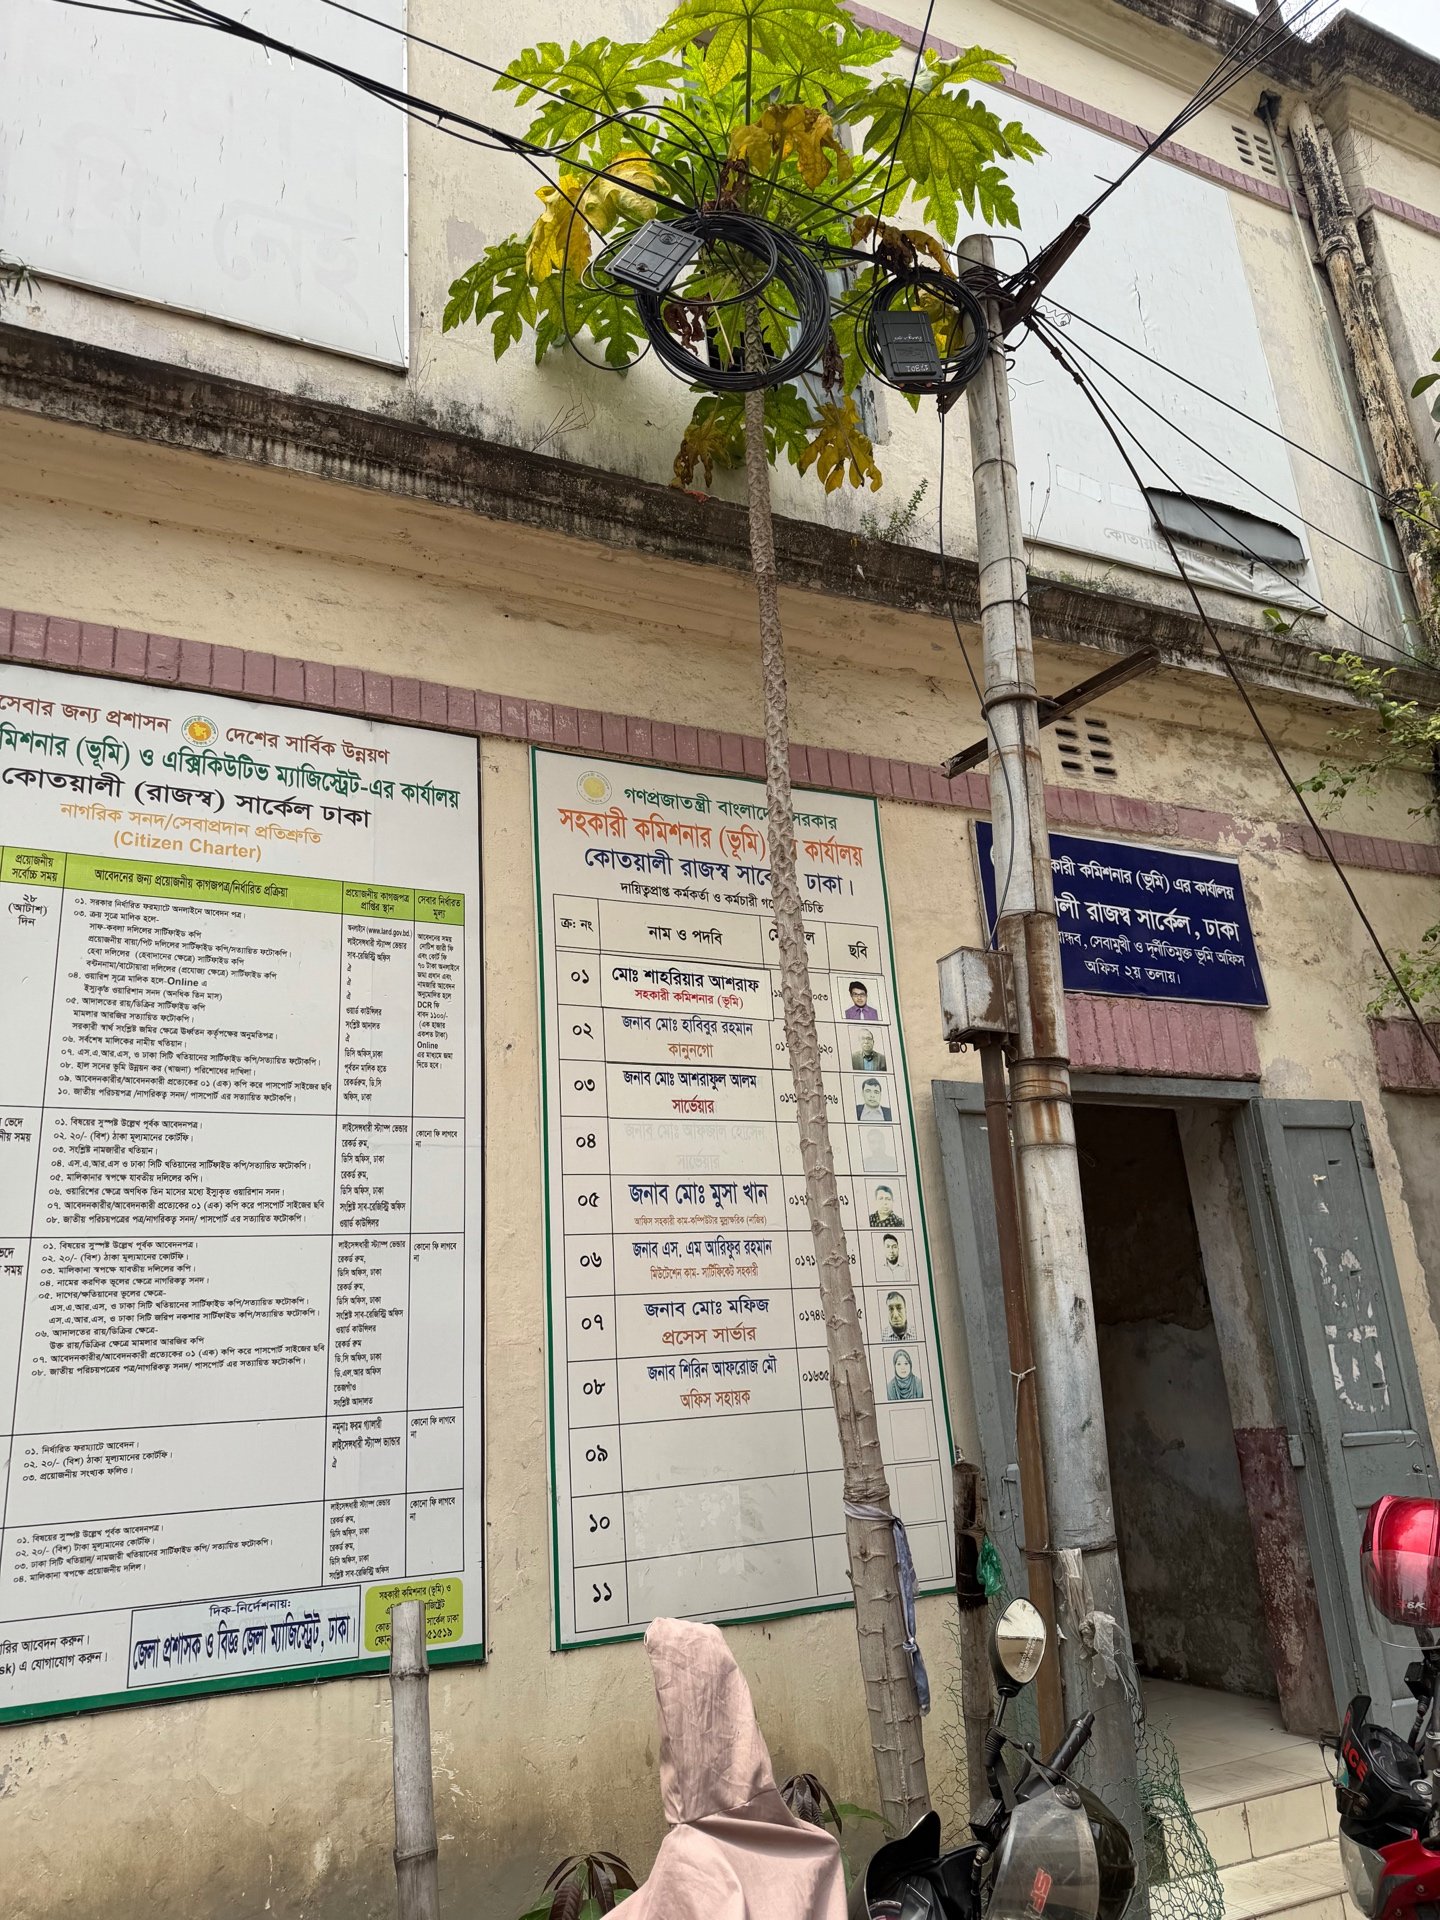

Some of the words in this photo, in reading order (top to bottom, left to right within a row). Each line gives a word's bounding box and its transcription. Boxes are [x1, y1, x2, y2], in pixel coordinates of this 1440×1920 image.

[60, 703, 101, 723] জন্য
[105, 709, 171, 733] প্রশাসন
[225, 727, 280, 749] দেশের
[284, 733, 337, 756] সার্বিক
[0, 720, 70, 757] মিশনার
[76, 735, 129, 770] (ভূমি)
[138, 749, 153, 766] ও
[399, 779, 460, 809] কার্যালয়
[2, 767, 125, 797] কোতয়ালী
[134, 780, 224, 812] (রাজস্ব)
[233, 794, 313, 820] সার্কেল
[319, 805, 371, 827] ঢাকা
[623, 787, 711, 813] গণপ্রজাতন্ত্রী
[715, 800, 767, 820] বাংলাদে
[59, 802, 123, 822] নাগরিক
[127, 811, 250, 837] সনদ/সেবাপ্রদান
[254, 822, 322, 843] প্রতিশ্রুতি
[113, 830, 182, 851] (Citizen
[189, 838, 261, 862] Charter)
[557, 806, 628, 839] সহকারী
[631, 812, 712, 849] কমিশনার
[718, 823, 765, 861] (ভূমি)
[801, 835, 863, 867] কার্যালয়
[15, 852, 54, 867] প্রয়োজনীয়
[584, 847, 674, 875] কোতয়ালী
[677, 858, 730, 881] রাজস্ব
[94, 869, 134, 882] আবেদনের
[135, 873, 152, 885] জন্য
[154, 875, 193, 888] প্রয়োজনীয়
[195, 879, 262, 894] কাগজপত্র/নির্ধারিত
[263, 884, 288, 897] প্রক্রিয়া
[1051, 855, 1076, 876] কারী
[1076, 859, 1132, 884] কমিশনার
[1135, 869, 1169, 893] (ভূমি)
[1172, 878, 1191, 893] এর
[1191, 878, 1234, 900] কার্যালয়
[22, 893, 37, 902] ২৮
[619, 880, 670, 898] দায়িত্বপ্রাপ্ত
[672, 885, 709, 901] কর্মকর্তা
[712, 893, 720, 902] ও
[723, 891, 758, 907] কর্মচারী
[17, 914, 36, 926] দিন
[579, 919, 593, 931] নং
[1083, 901, 1131, 926] রাজস্ব
[1201, 918, 1239, 941] ঢাকা
[647, 925, 672, 940] নাম
[676, 929, 686, 940] ও
[691, 927, 722, 945] পদবি
[847, 940, 867, 959] ছবি
[1089, 934, 1130, 954] সেবামুখী
[1133, 941, 1143, 952] ও
[1193, 945, 1213, 965] ভূমি
[1214, 948, 1245, 966] অফিস
[570, 969, 589, 983] ০১
[611, 967, 638, 982] মোঃ
[642, 966, 704, 987] শাহরিয়ার
[707, 975, 759, 992] আশরাফ
[1083, 957, 1119, 976] অফিস
[1124, 965, 1141, 979] ২য়
[1143, 967, 1180, 984] তলায়।
[634, 987, 669, 1000] সহকারী
[672, 989, 714, 1004] কমিশনার
[717, 993, 743, 1009] (ভূমি)
[572, 1022, 593, 1039] ০২
[621, 1015, 651, 1029] জনাব
[655, 1017, 677, 1031] মোঃ
[680, 1014, 717, 1036] হাবিবুর
[720, 1018, 754, 1036] রহমান
[416, 1040, 438, 1049] Online
[667, 1042, 713, 1060] কানুনগো
[573, 1078, 595, 1091] ০৩
[622, 1070, 651, 1085] জনাব
[654, 1071, 674, 1086] মোঃ
[677, 1071, 726, 1091] আশরাফুল
[728, 1073, 756, 1087] আলম
[671, 1094, 714, 1113] সার্ভেয়ার
[575, 1133, 596, 1148] ০৪
[577, 1192, 599, 1207] ০৫
[627, 1182, 669, 1204] জনাব
[675, 1181, 705, 1204] মোঃ
[708, 1181, 738, 1209] মুসা
[742, 1181, 768, 1203] খান
[631, 1241, 658, 1257] জনাব
[661, 1241, 681, 1257] এস.
[685, 1241, 702, 1256] এম
[703, 1234, 741, 1260] আরিফুর
[742, 1238, 772, 1256] রহমান
[579, 1251, 602, 1267] ০৬
[643, 1300, 686, 1317] জনাব
[692, 1299, 722, 1315] মোঃ
[726, 1294, 769, 1313] মফিজ
[581, 1314, 603, 1330] ০৭
[661, 1329, 707, 1346] প্রসেস
[711, 1321, 757, 1342] সার্ভার
[646, 1364, 676, 1380] জনাব
[678, 1357, 709, 1378] শিরিন
[711, 1359, 758, 1376] আফরোজ
[762, 1353, 777, 1373] মৌ
[582, 1378, 605, 1395] ০৮
[679, 1387, 711, 1408] অফিস
[713, 1389, 750, 1407] সহায়ক
[585, 1444, 608, 1461] ০৯
[589, 1513, 610, 1532] ১০
[592, 1582, 612, 1602] ১১
[132, 1638, 160, 1670] জেলা
[162, 1632, 202, 1666] প্রশাসক
[205, 1632, 213, 1658] ও
[216, 1619, 240, 1658] বিজ্ঞ
[241, 1622, 268, 1655] জেলা
